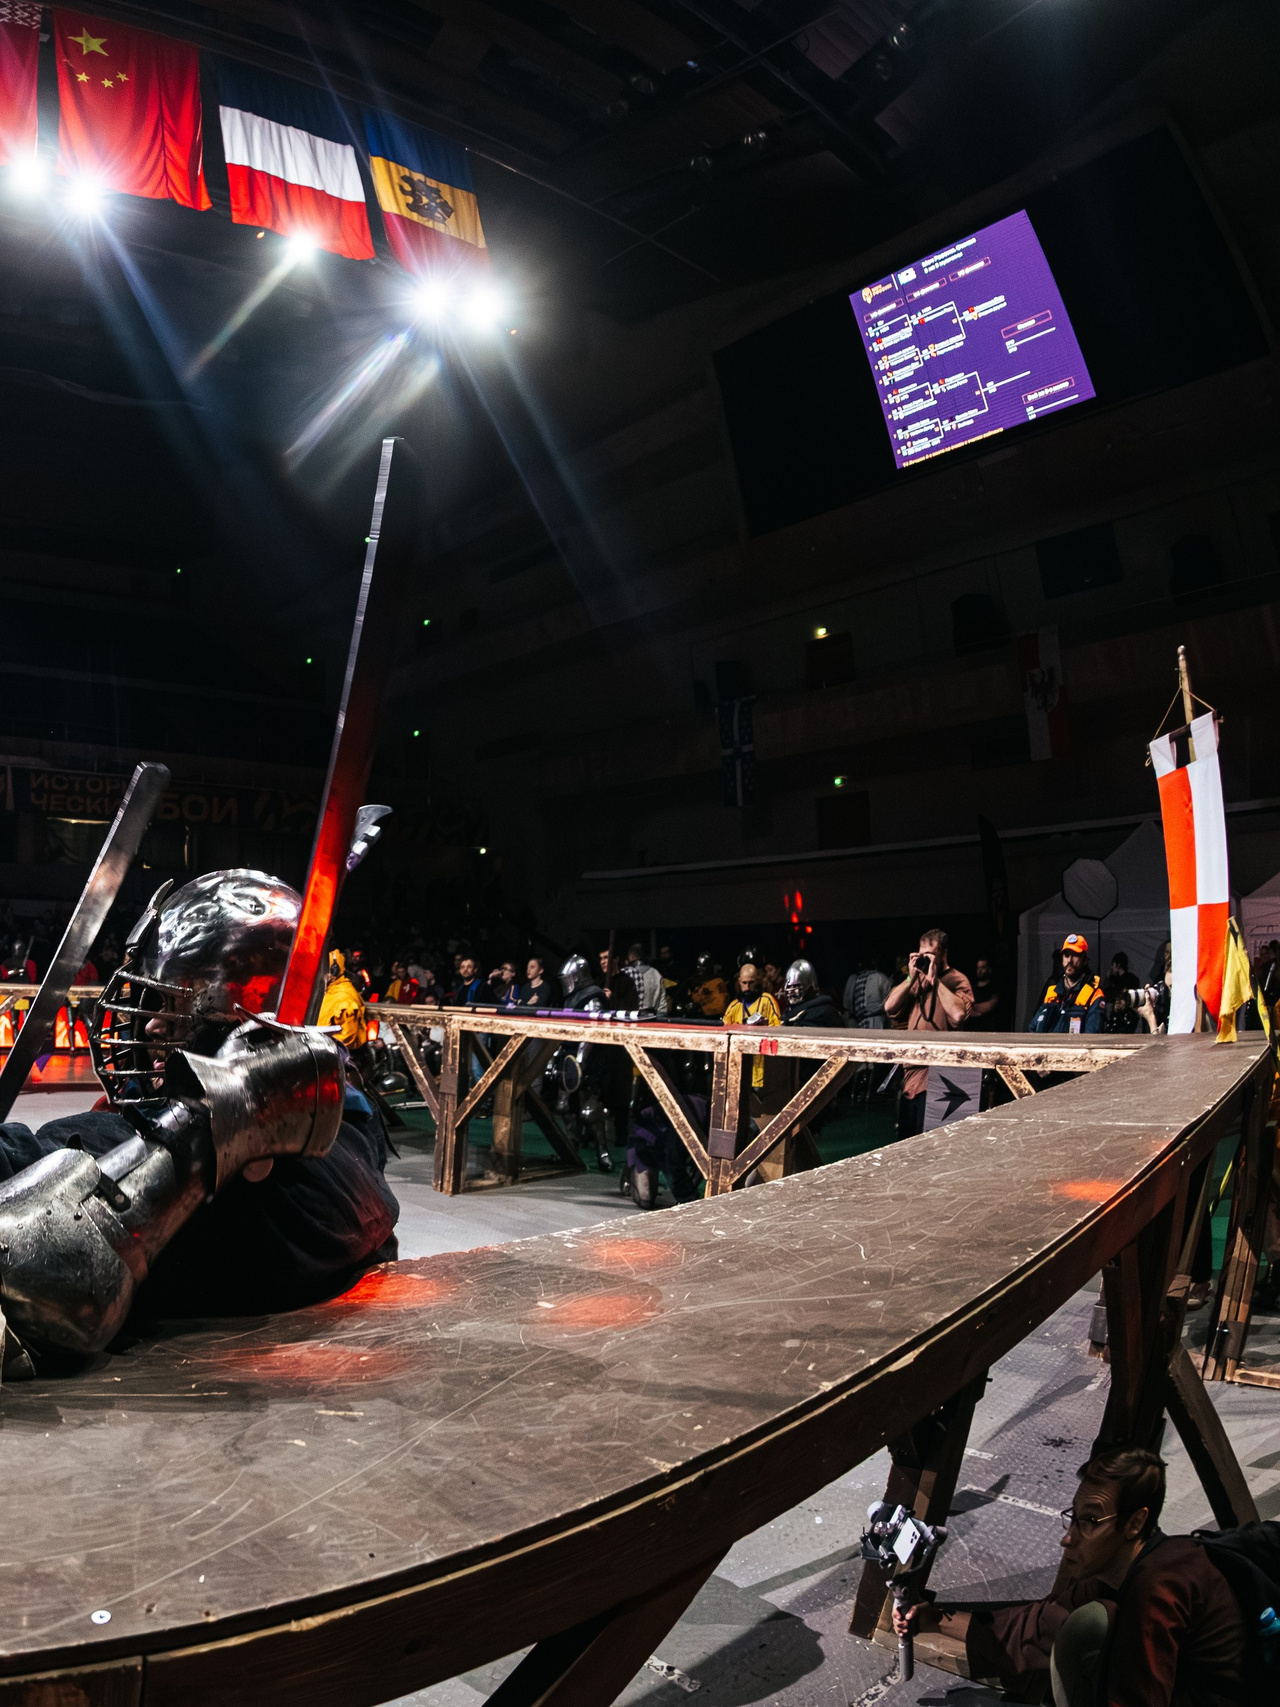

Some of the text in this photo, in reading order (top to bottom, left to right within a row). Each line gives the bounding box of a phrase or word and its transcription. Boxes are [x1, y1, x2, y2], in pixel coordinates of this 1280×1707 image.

[30, 772, 128, 795] ИСТОР
[30, 792, 122, 816] ЧЕСКИ
[156, 792, 238, 825] БОИ
